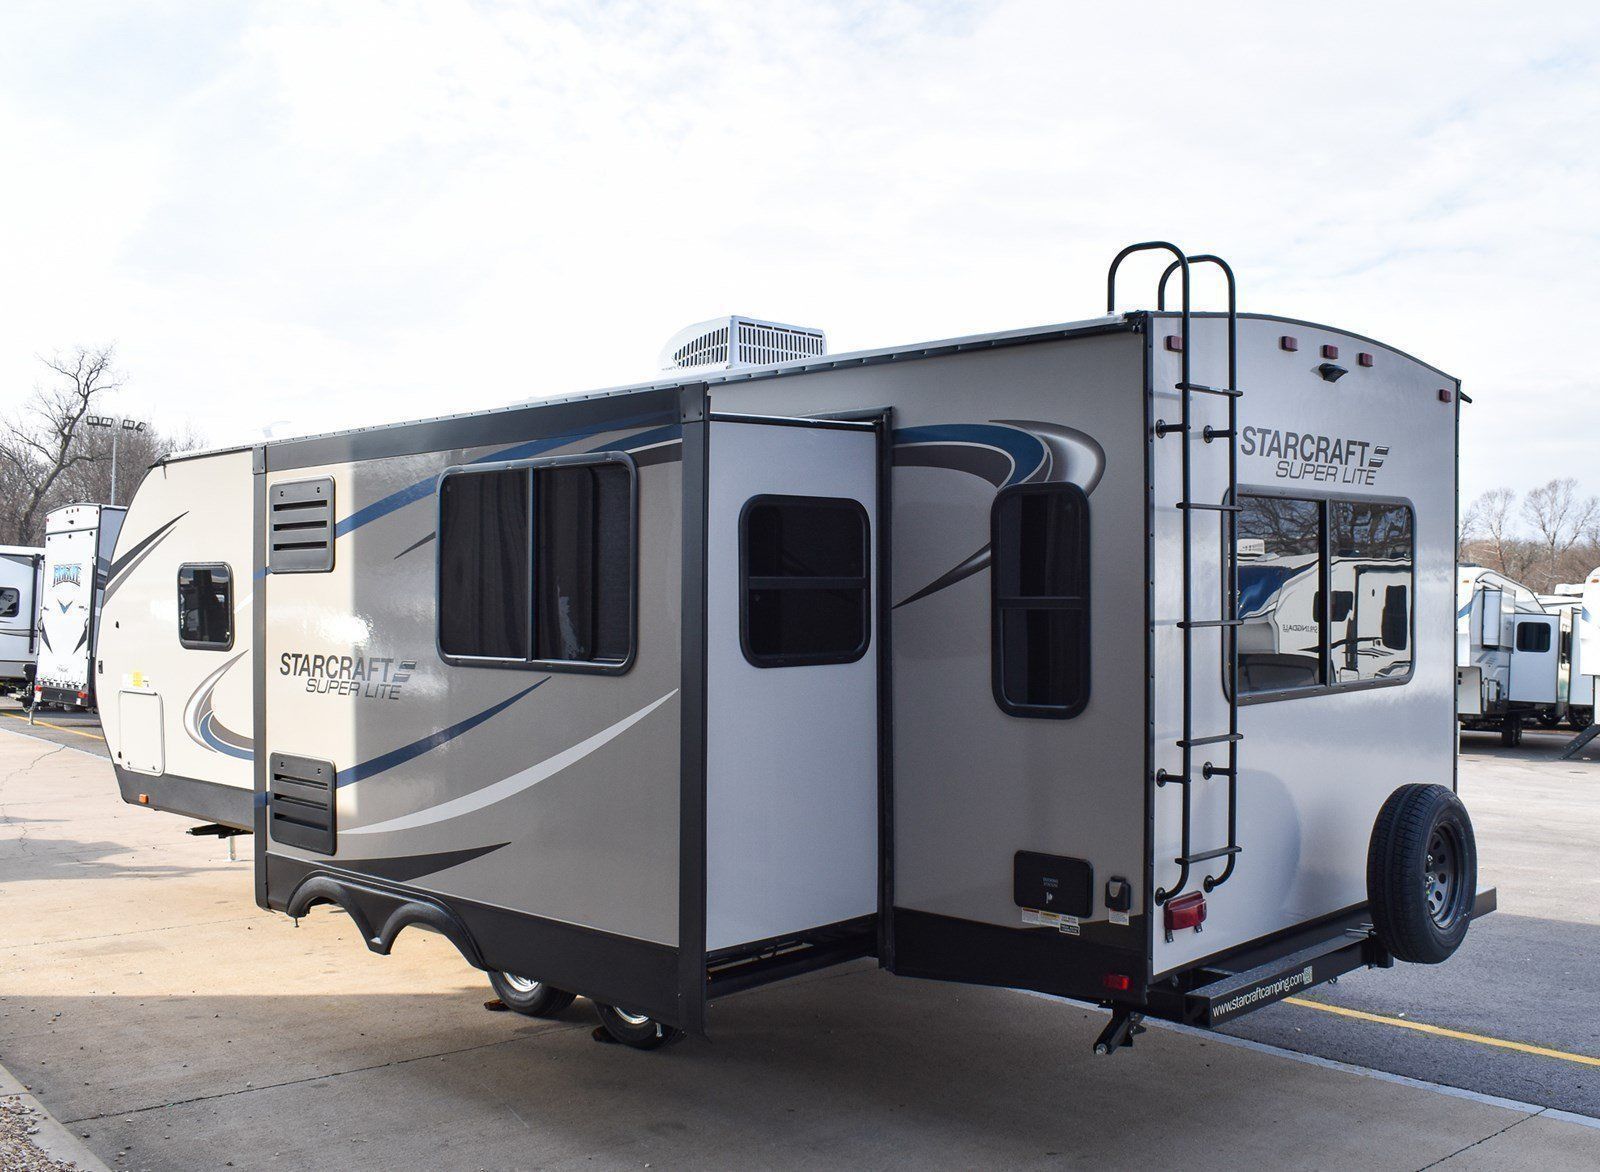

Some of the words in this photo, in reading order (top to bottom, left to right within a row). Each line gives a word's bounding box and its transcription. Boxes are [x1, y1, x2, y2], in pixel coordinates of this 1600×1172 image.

[1241, 426, 1370, 467] STARCRAFT
[1276, 460, 1338, 482] SUPER
[1342, 468, 1377, 486] LITE
[280, 652, 394, 682] STARCRAFT
[306, 678, 360, 696] SUPER
[365, 683, 402, 700] LITE
[1212, 972, 1305, 1018] www.starcraftcamping.com
